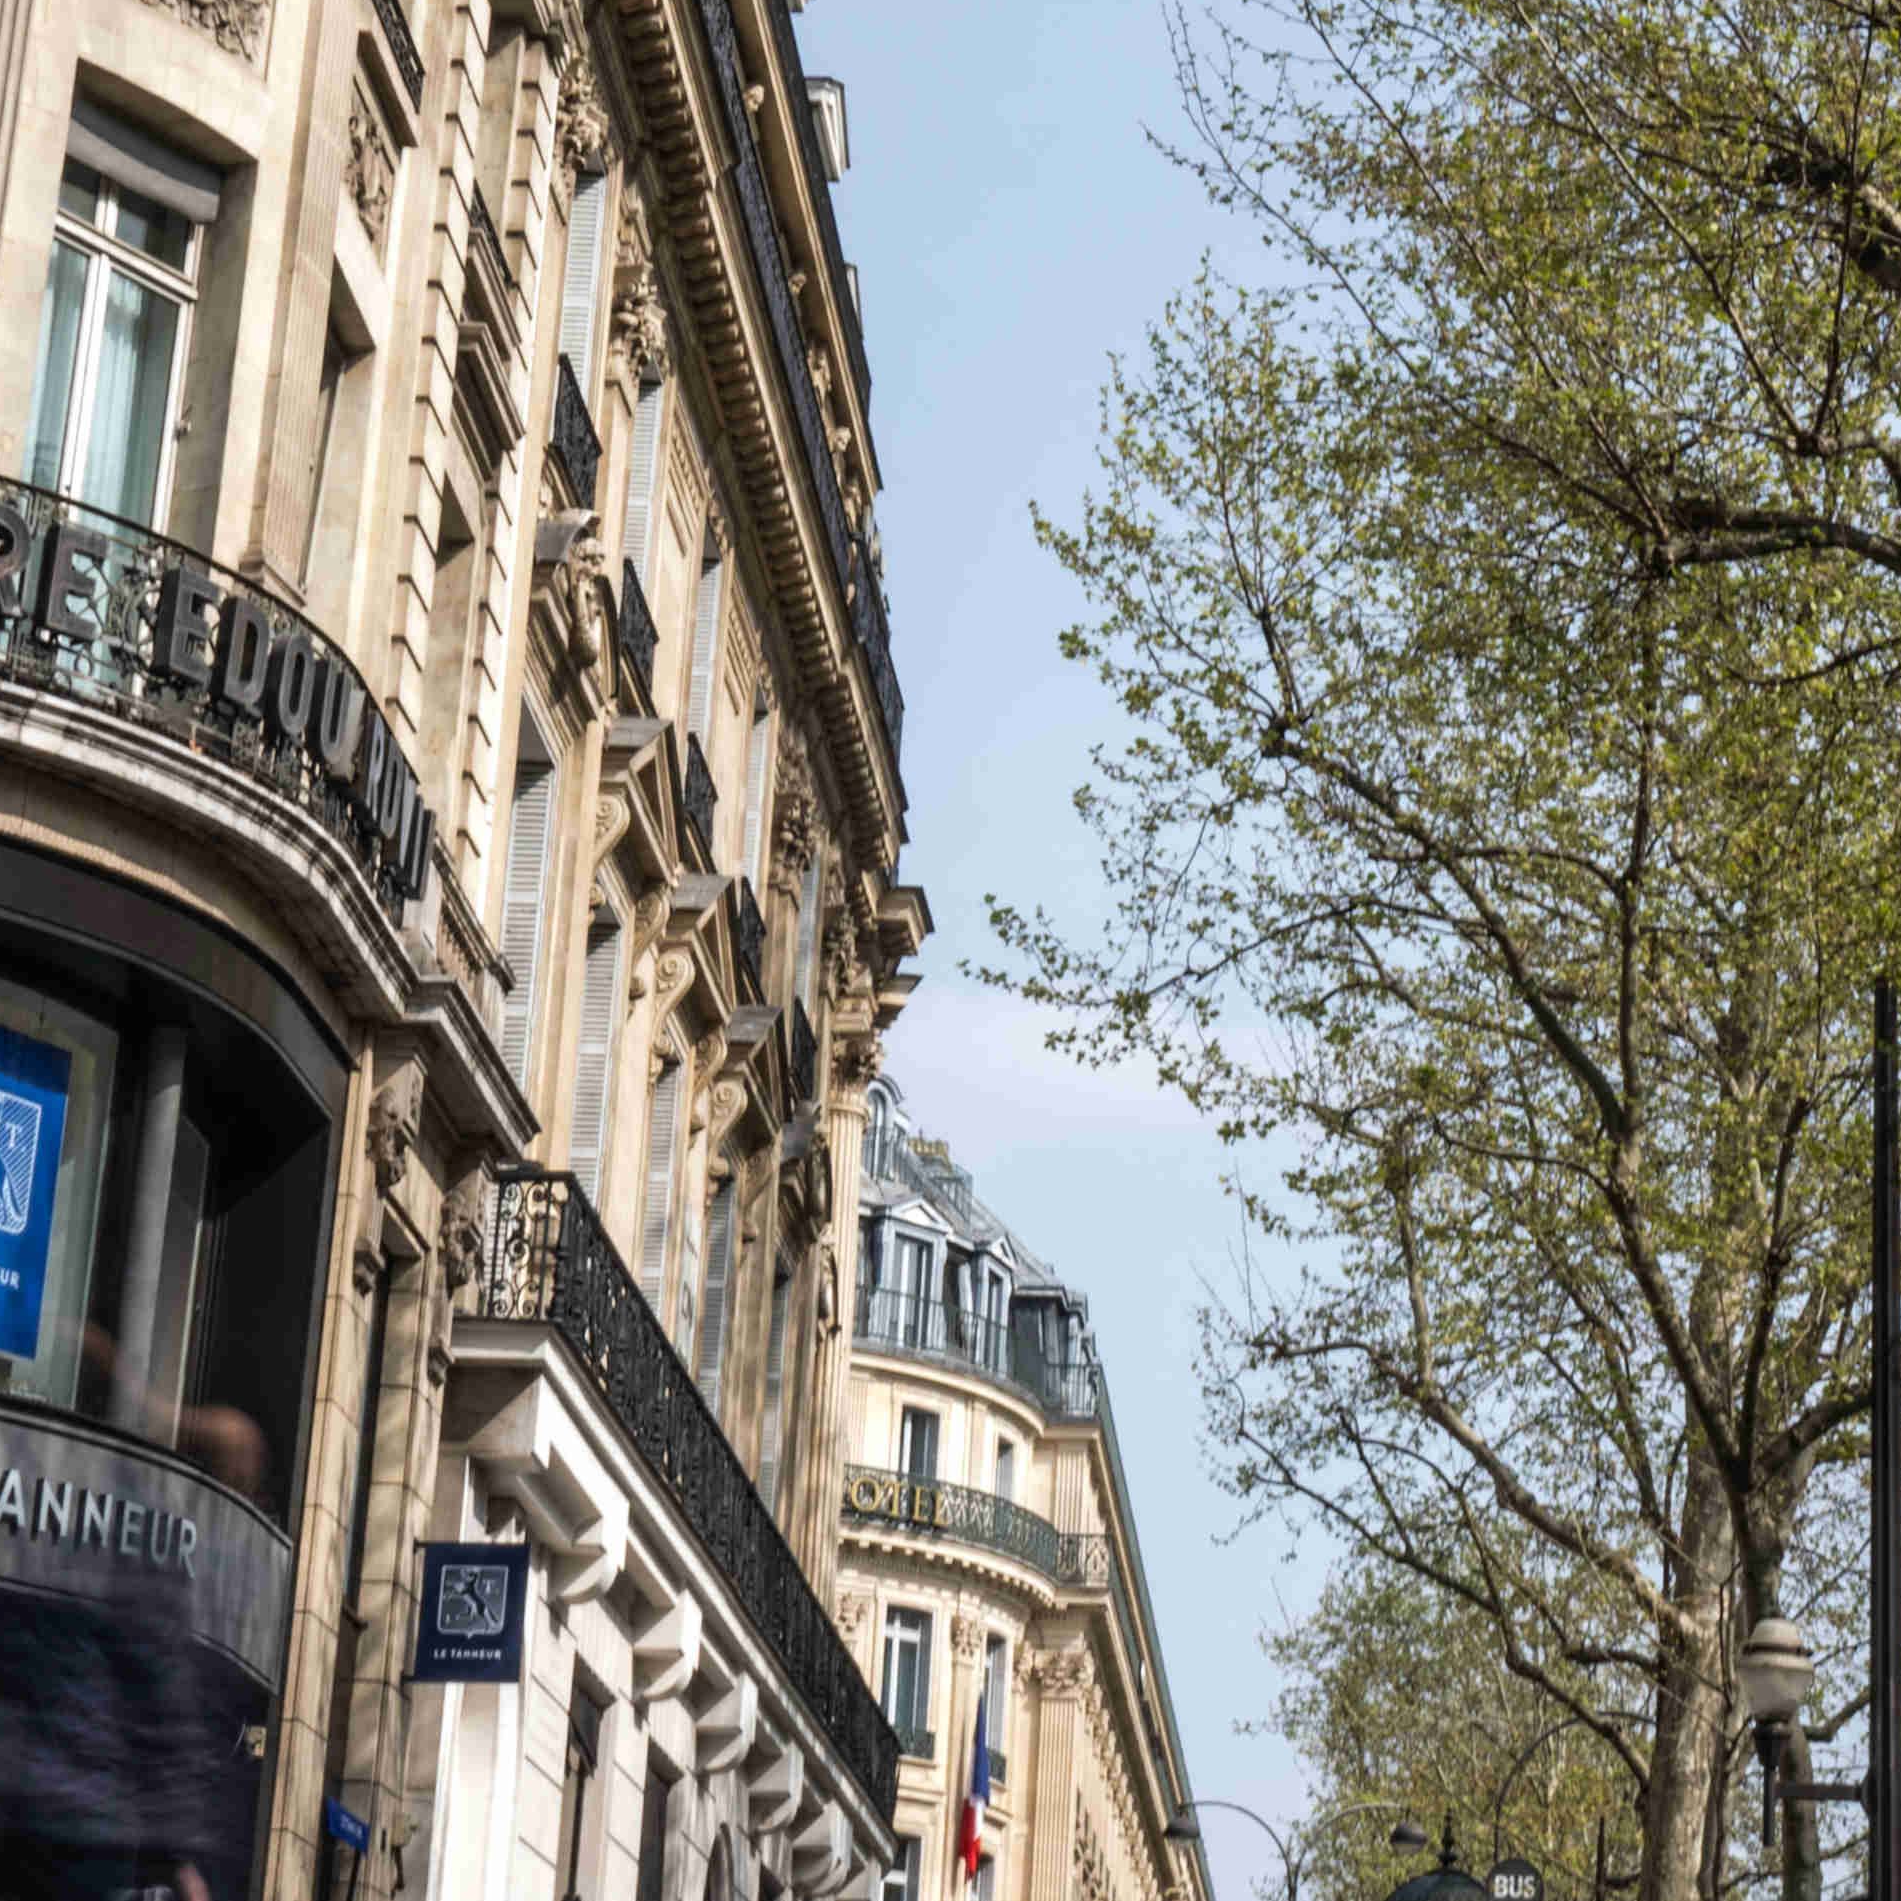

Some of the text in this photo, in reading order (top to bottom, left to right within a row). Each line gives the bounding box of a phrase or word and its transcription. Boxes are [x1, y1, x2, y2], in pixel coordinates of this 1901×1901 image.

[151, 567, 405, 838] EDOURD
[851, 1476, 949, 1526] OTEL
[433, 1647, 447, 1660] LE
[1494, 1874, 1535, 1899] BUS
